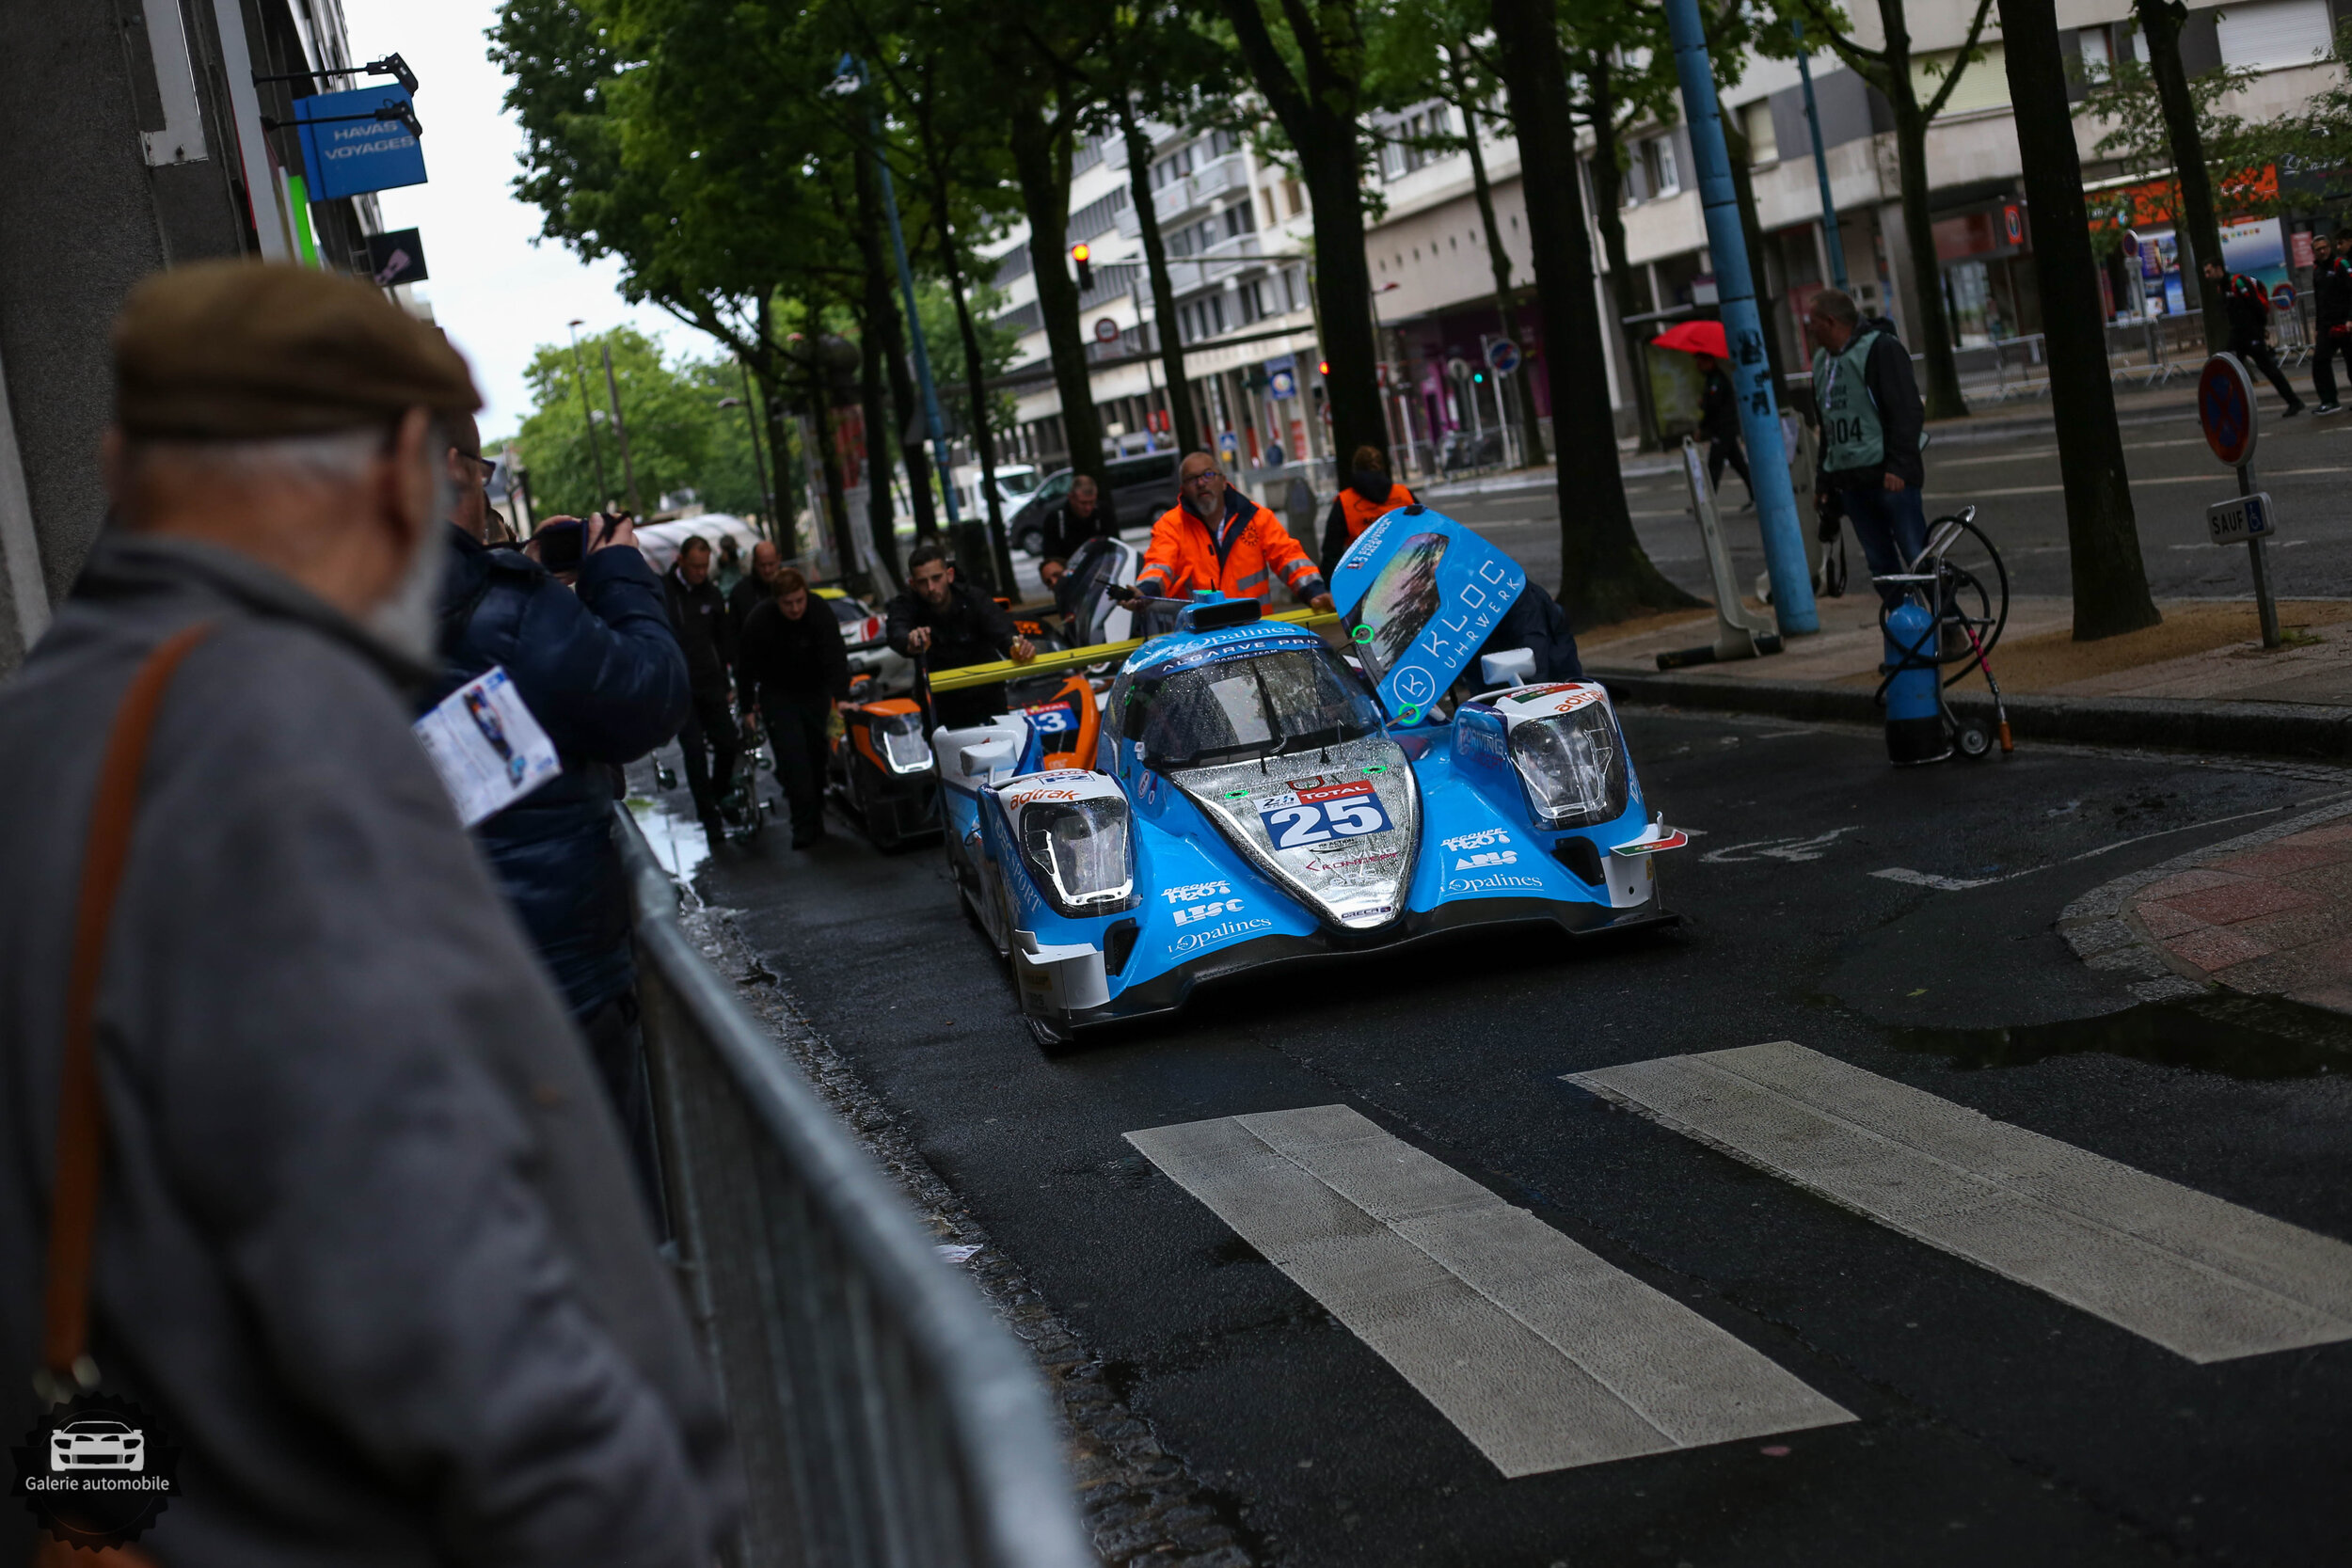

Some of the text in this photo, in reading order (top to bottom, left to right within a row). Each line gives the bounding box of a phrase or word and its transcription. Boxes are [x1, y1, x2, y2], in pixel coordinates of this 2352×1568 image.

[333, 120, 399, 141] HAVAS
[325, 135, 415, 160] VOYAGES
[2212, 511, 2243, 534] SAUF
[1422, 560, 1505, 657] KLOC
[1444, 578, 1521, 669] UHRWERK
[1163, 641, 1267, 672] ALGARVE
[1278, 639, 1319, 647] PRO
[1009, 788, 1082, 811] adtrak
[1301, 785, 1369, 800] TOTAL
[1270, 795, 1383, 847] 25
[1009, 857, 1042, 912] SPORT
[1449, 873, 1544, 893] Opalines
[1176, 918, 1272, 951] Opalines
